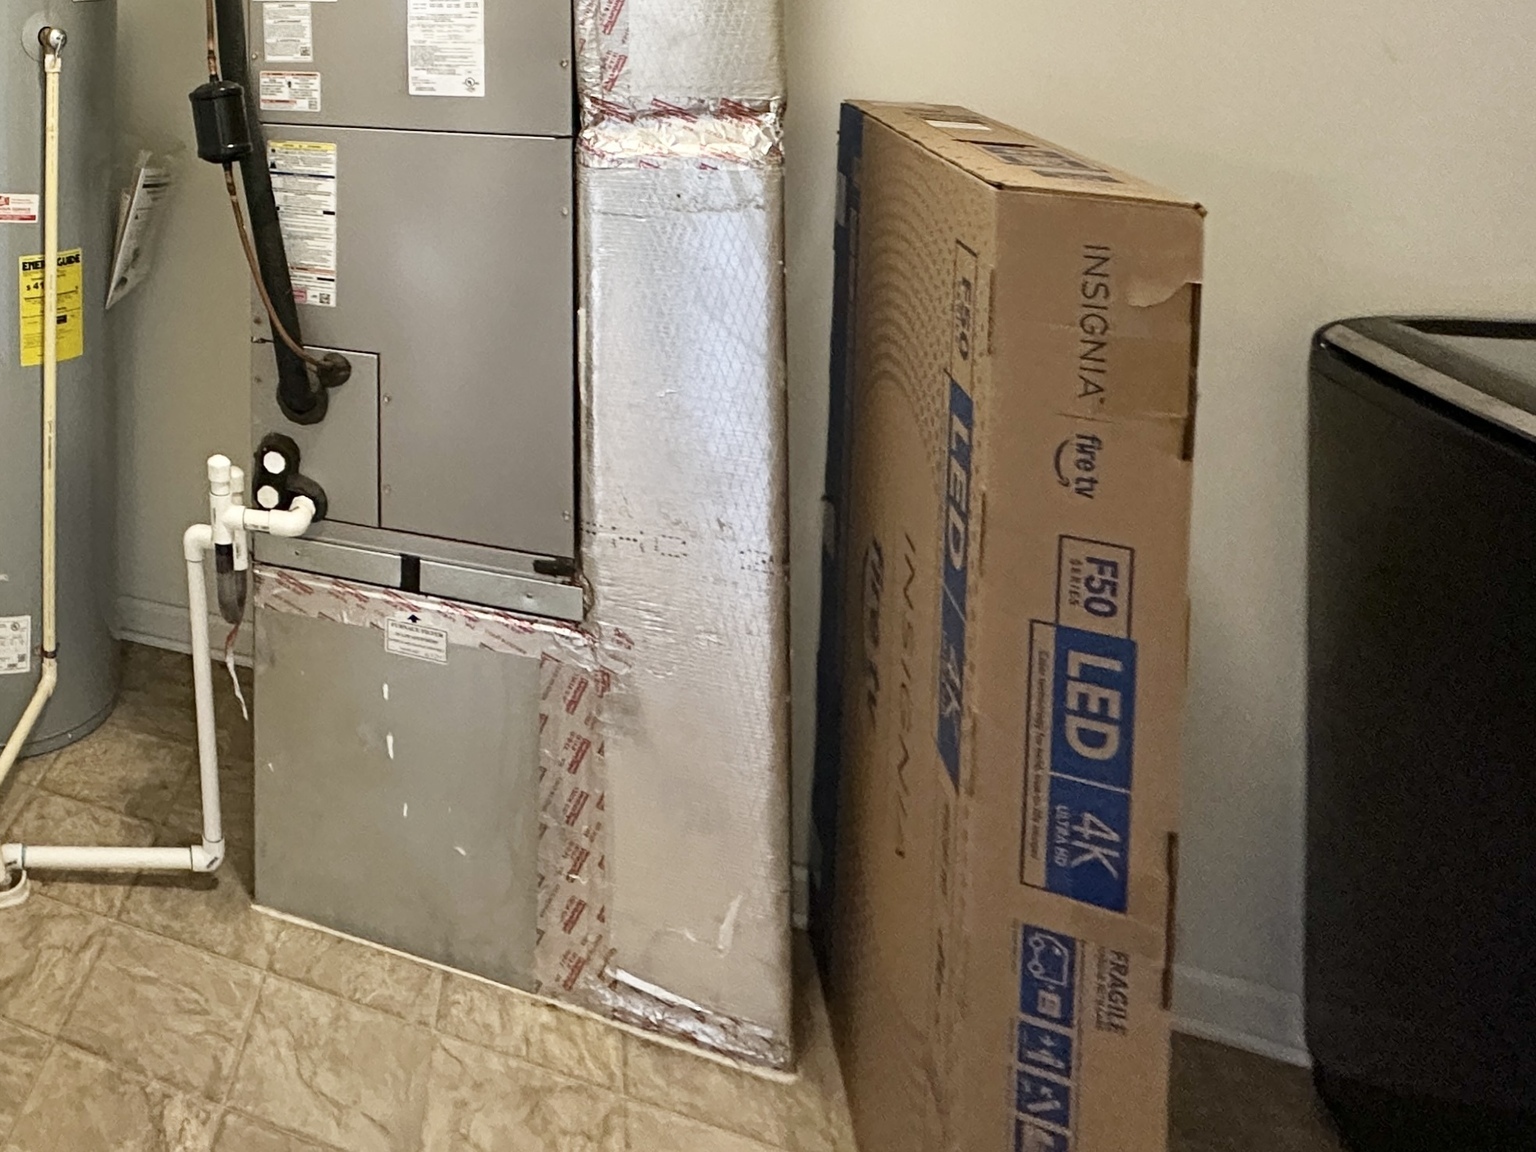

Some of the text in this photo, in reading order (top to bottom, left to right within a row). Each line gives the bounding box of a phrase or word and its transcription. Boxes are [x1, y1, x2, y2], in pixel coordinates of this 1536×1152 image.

[1078, 244, 1111, 398] INSIGNIA
[948, 414, 970, 570] LED
[1074, 433, 1103, 500] fire tv
[1068, 558, 1083, 607] SERIES
[1083, 556, 1119, 618] F50
[1065, 650, 1124, 761] LED
[1054, 803, 1071, 843] ULTRA
[1071, 811, 1121, 880] 4K
[1108, 949, 1129, 1036] FRAGILE
